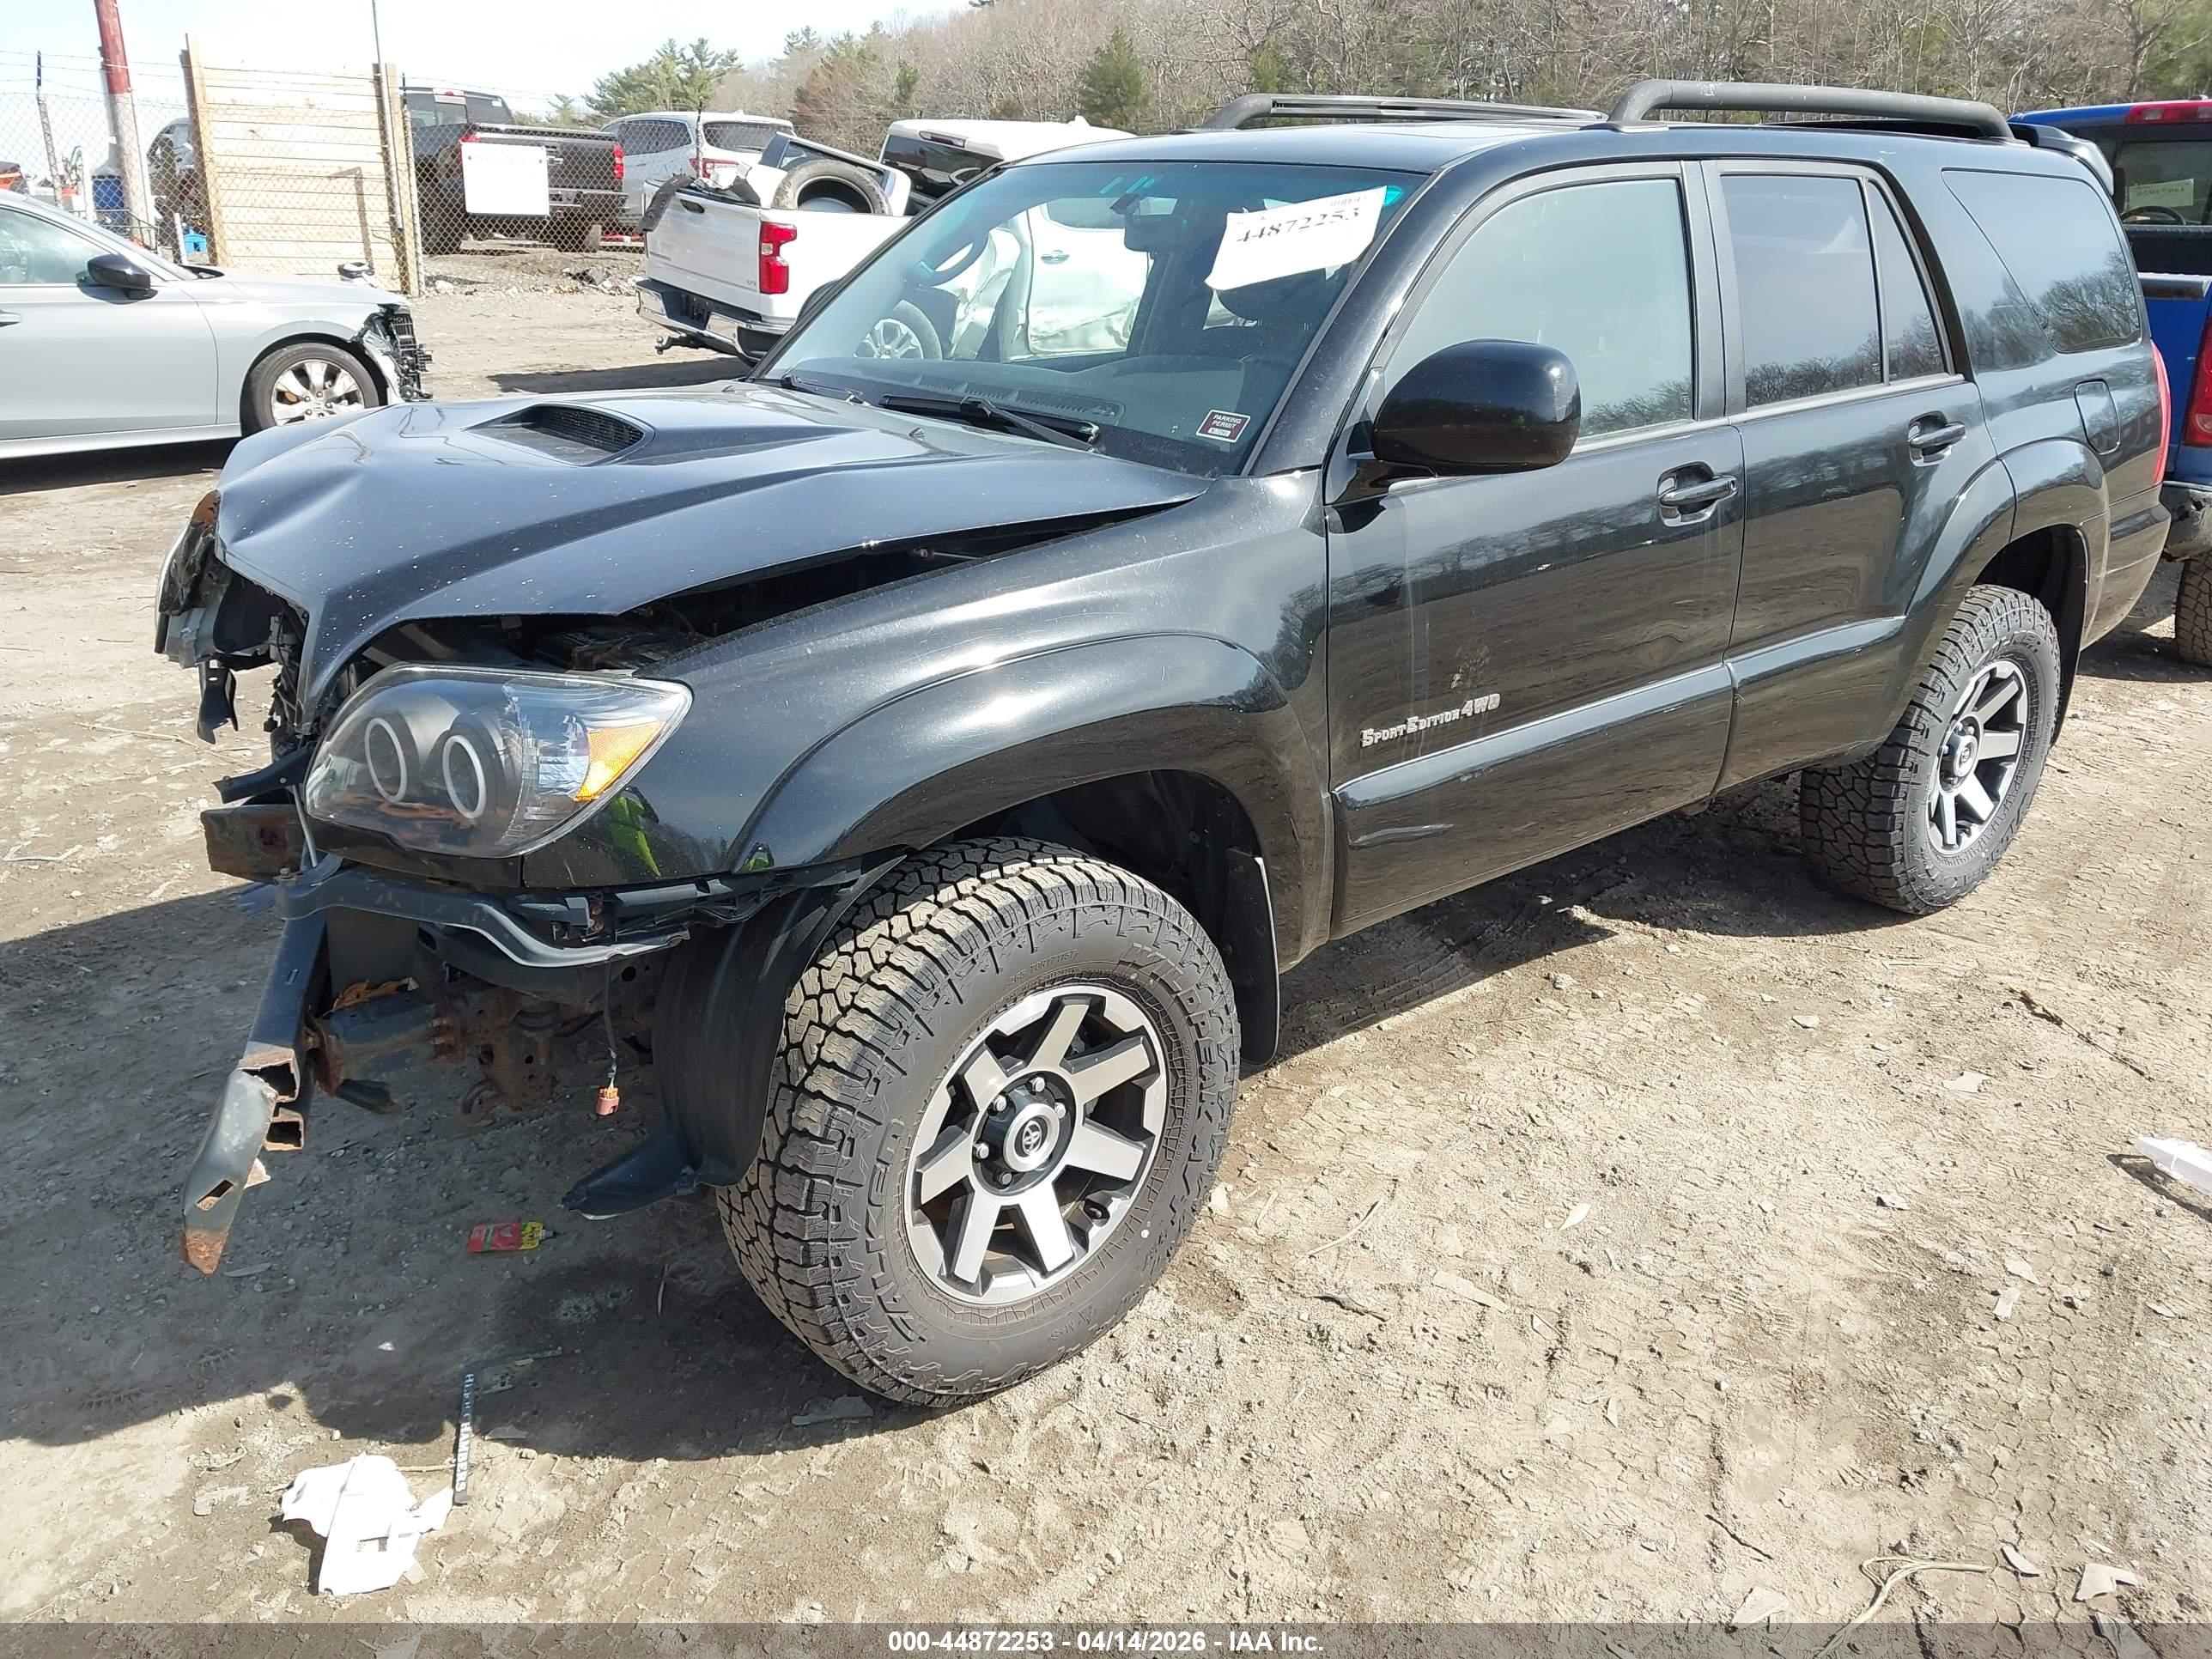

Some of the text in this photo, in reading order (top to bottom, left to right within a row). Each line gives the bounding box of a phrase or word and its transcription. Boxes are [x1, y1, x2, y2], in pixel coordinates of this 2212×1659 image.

[1212, 421, 1237, 429] PERMIT
[1213, 415, 1242, 424] PARKING
[1461, 692, 1502, 718] 4WD
[1118, 942, 1218, 1123] WILDPEAK
[456, 1413, 471, 1492] CHAMBERS
